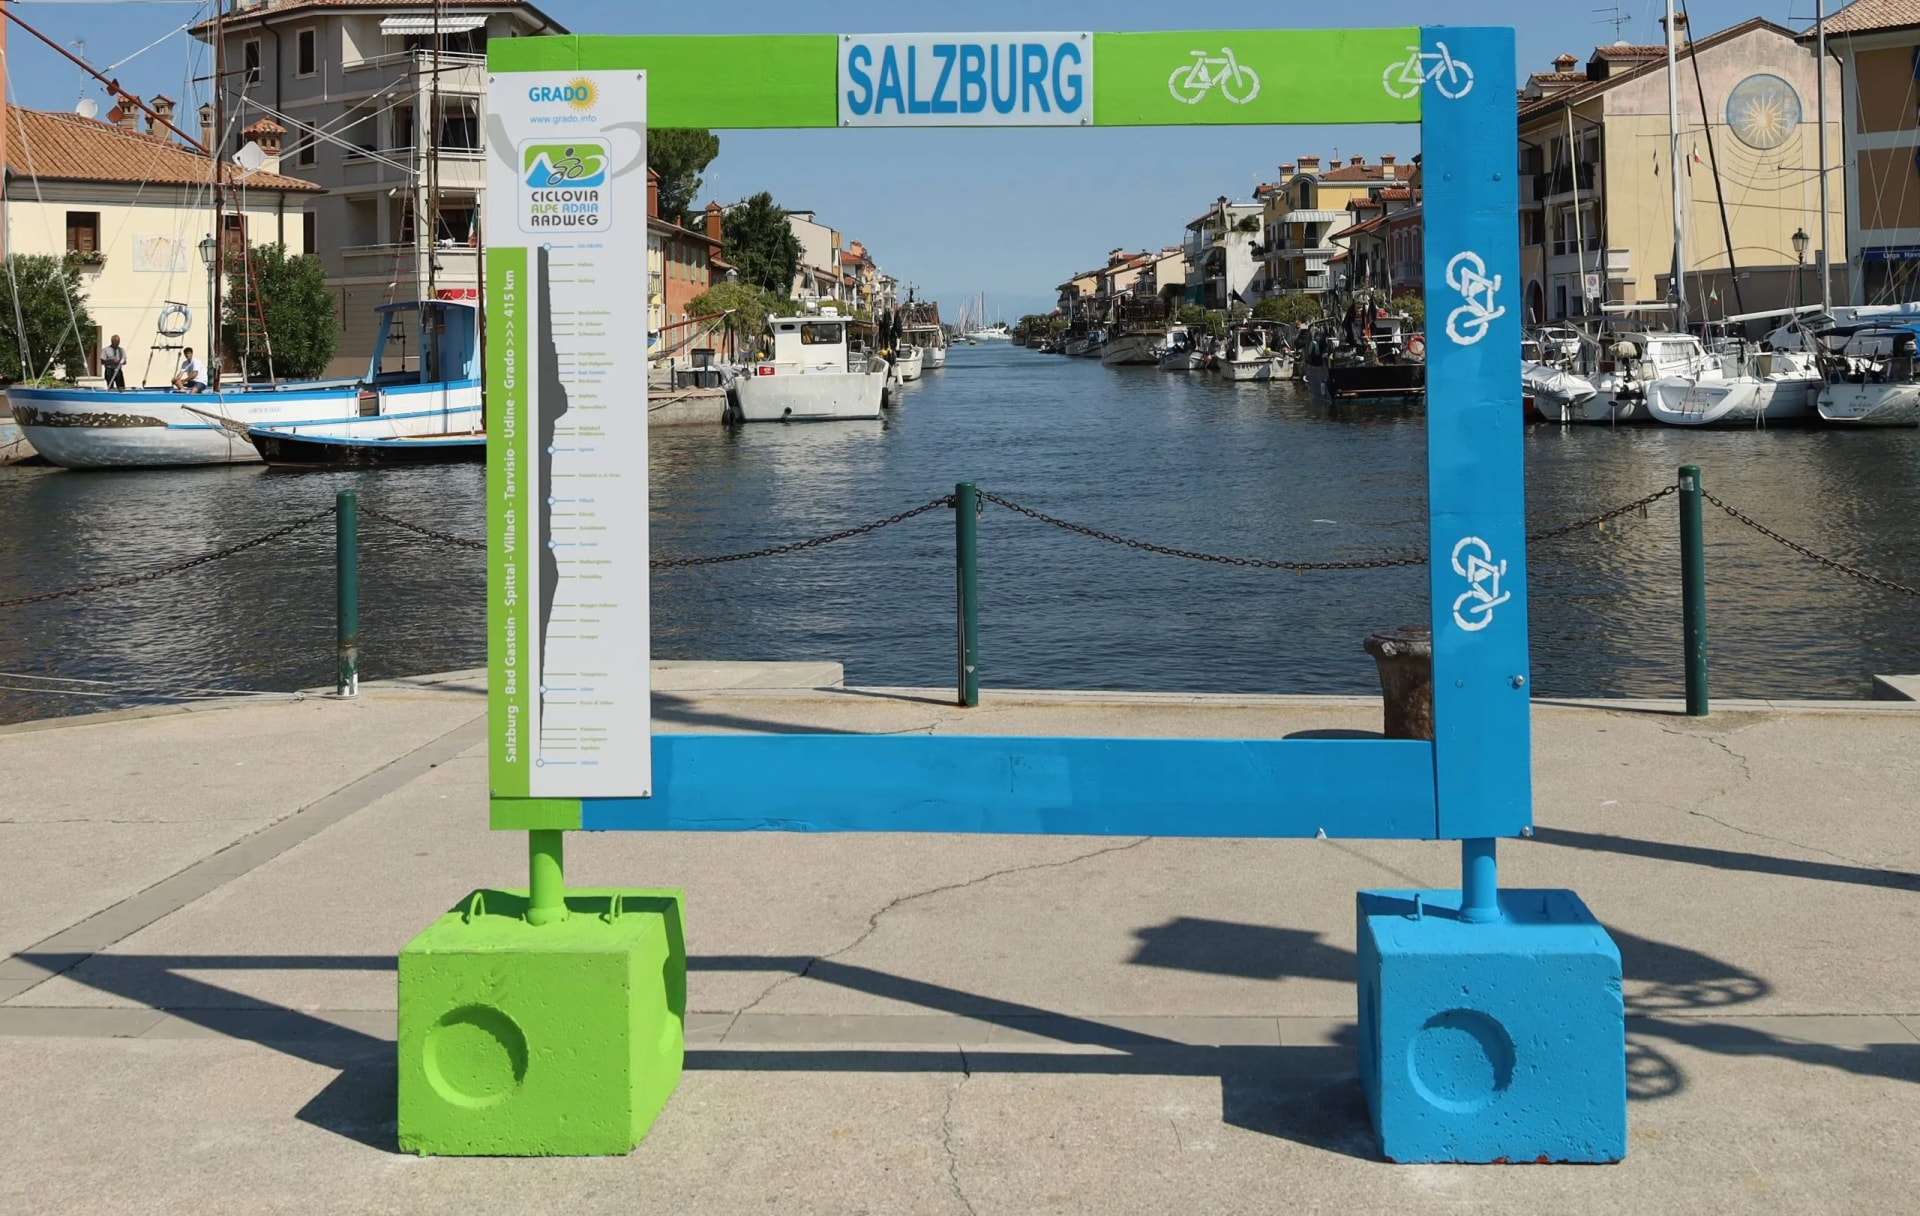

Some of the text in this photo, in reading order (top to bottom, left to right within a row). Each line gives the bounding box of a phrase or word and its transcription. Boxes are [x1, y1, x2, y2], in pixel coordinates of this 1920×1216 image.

[529, 86, 588, 102] GRADO
[847, 42, 1083, 116] SALZBURG
[529, 114, 597, 124] www.grado.info
[531, 190, 599, 203] CICLOVIA
[531, 203, 599, 214] ALPE ADRIA
[531, 214, 599, 227] RADWEG
[504, 270, 514, 290] km
[504, 293, 514, 317] 415
[504, 349, 514, 389] Grado
[504, 400, 514, 438] Udine
[504, 449, 515, 500] Tarvisio
[504, 510, 515, 553] Villach
[504, 563, 517, 606] Spittal
[505, 617, 516, 667] Gastein
[505, 670, 516, 695] Bad
[505, 705, 519, 763] Salzburg
